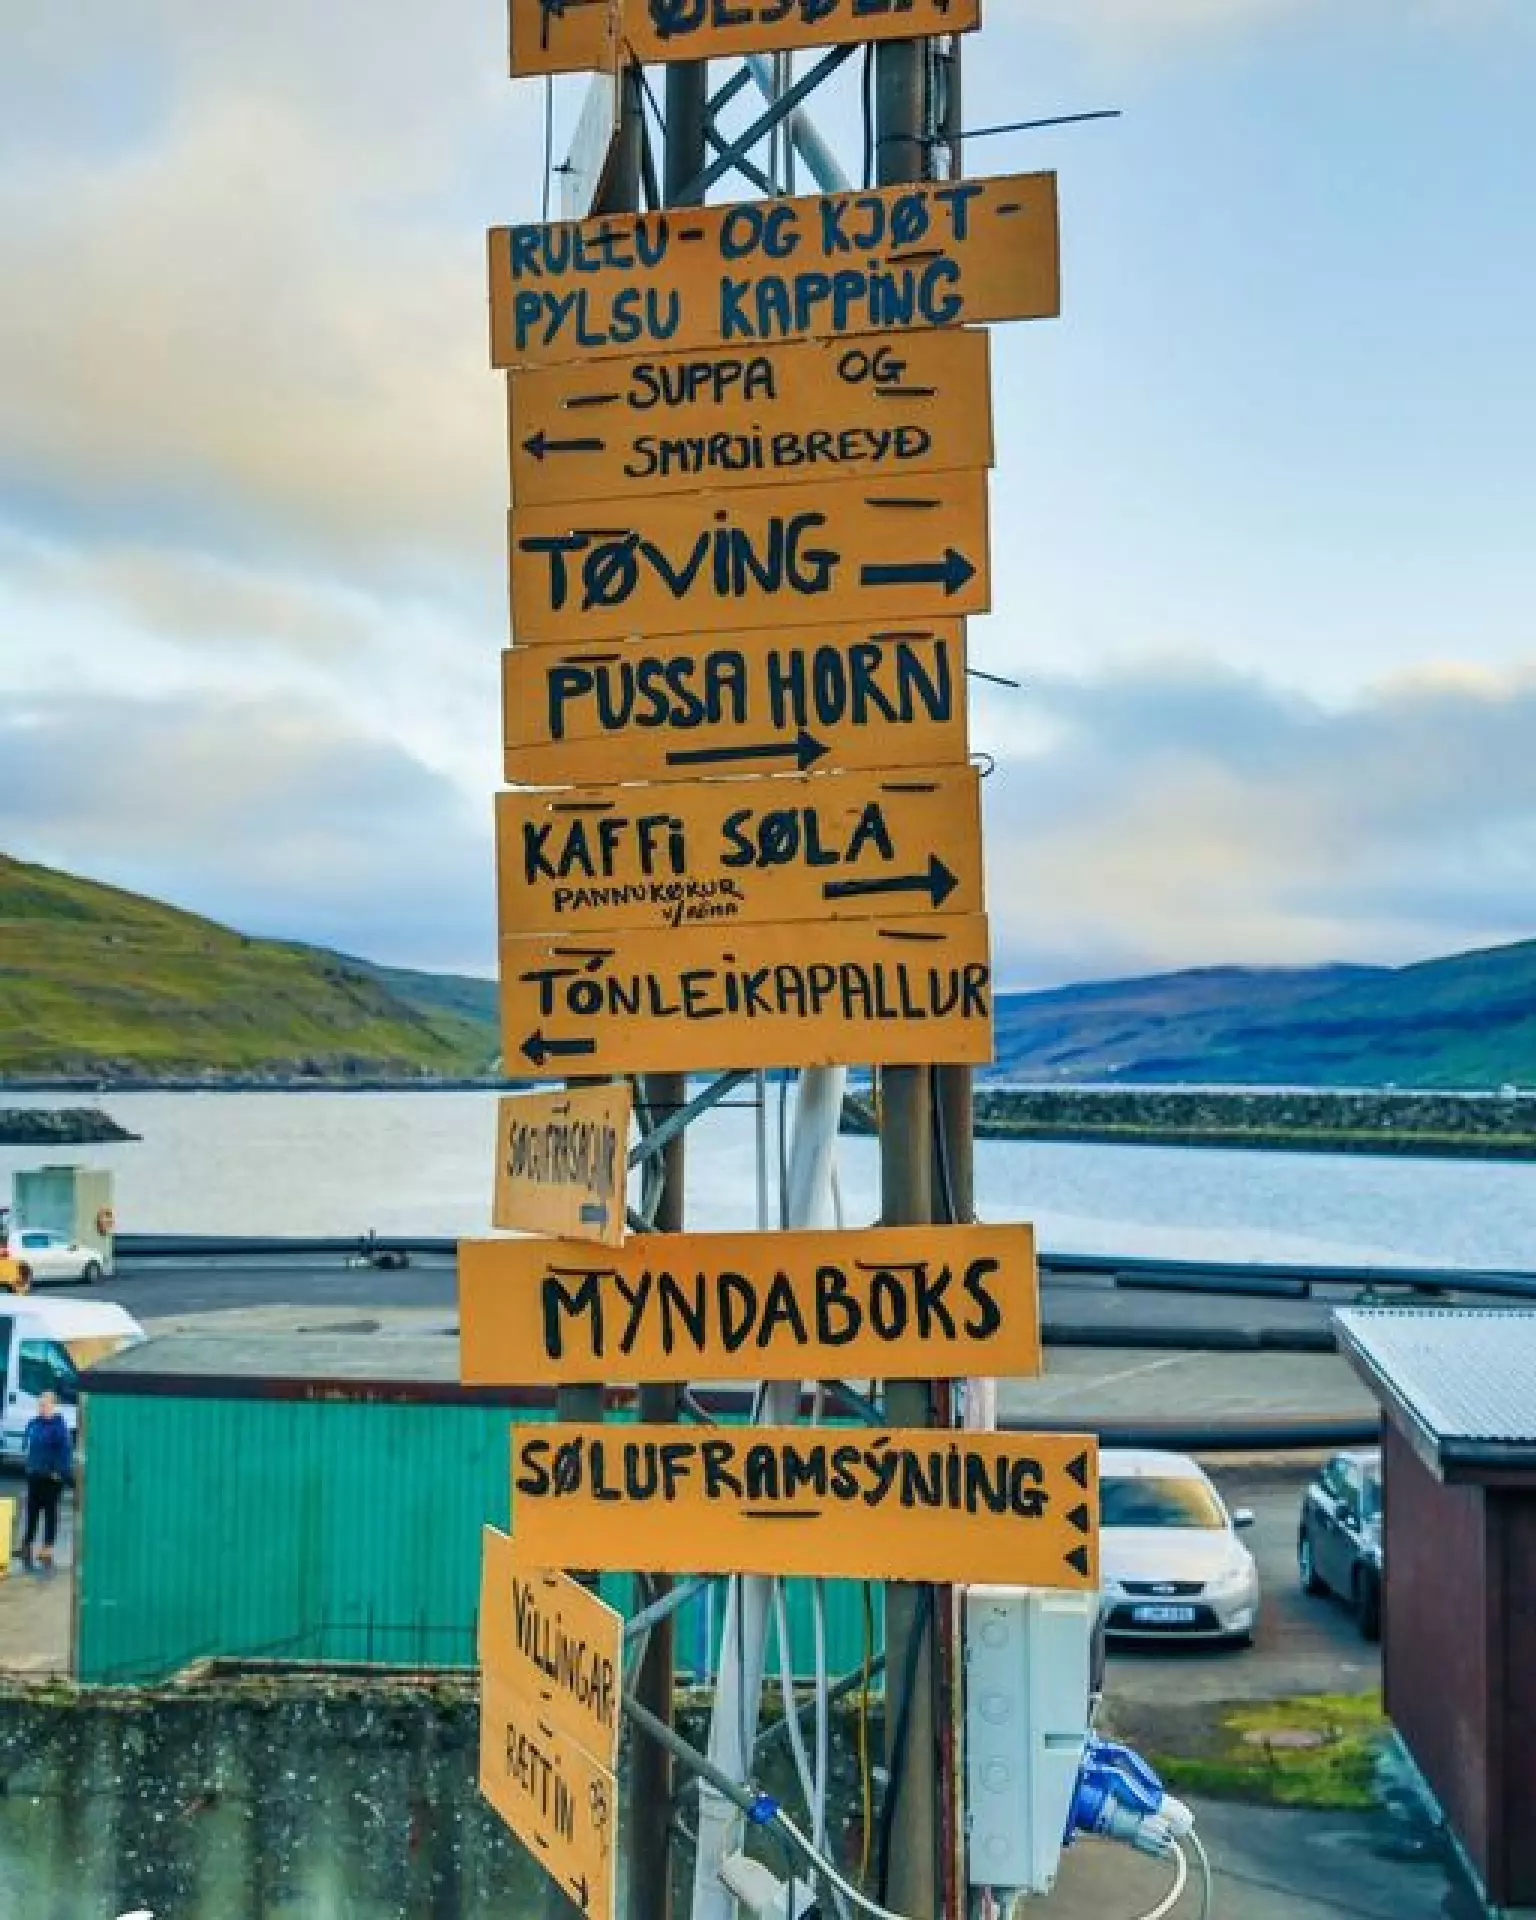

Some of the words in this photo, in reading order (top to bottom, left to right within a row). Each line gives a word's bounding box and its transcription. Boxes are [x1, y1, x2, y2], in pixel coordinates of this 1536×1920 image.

[718, 206, 801, 261] OG
[514, 286, 680, 350] PYLSU
[627, 356, 777, 409] SUPPA
[836, 347, 906, 385] OG
[546, 650, 746, 741] PUSSA
[767, 639, 952, 729] HORN
[720, 801, 895, 868] SØLA
[541, 1257, 1001, 1360] MYNDABOKS
